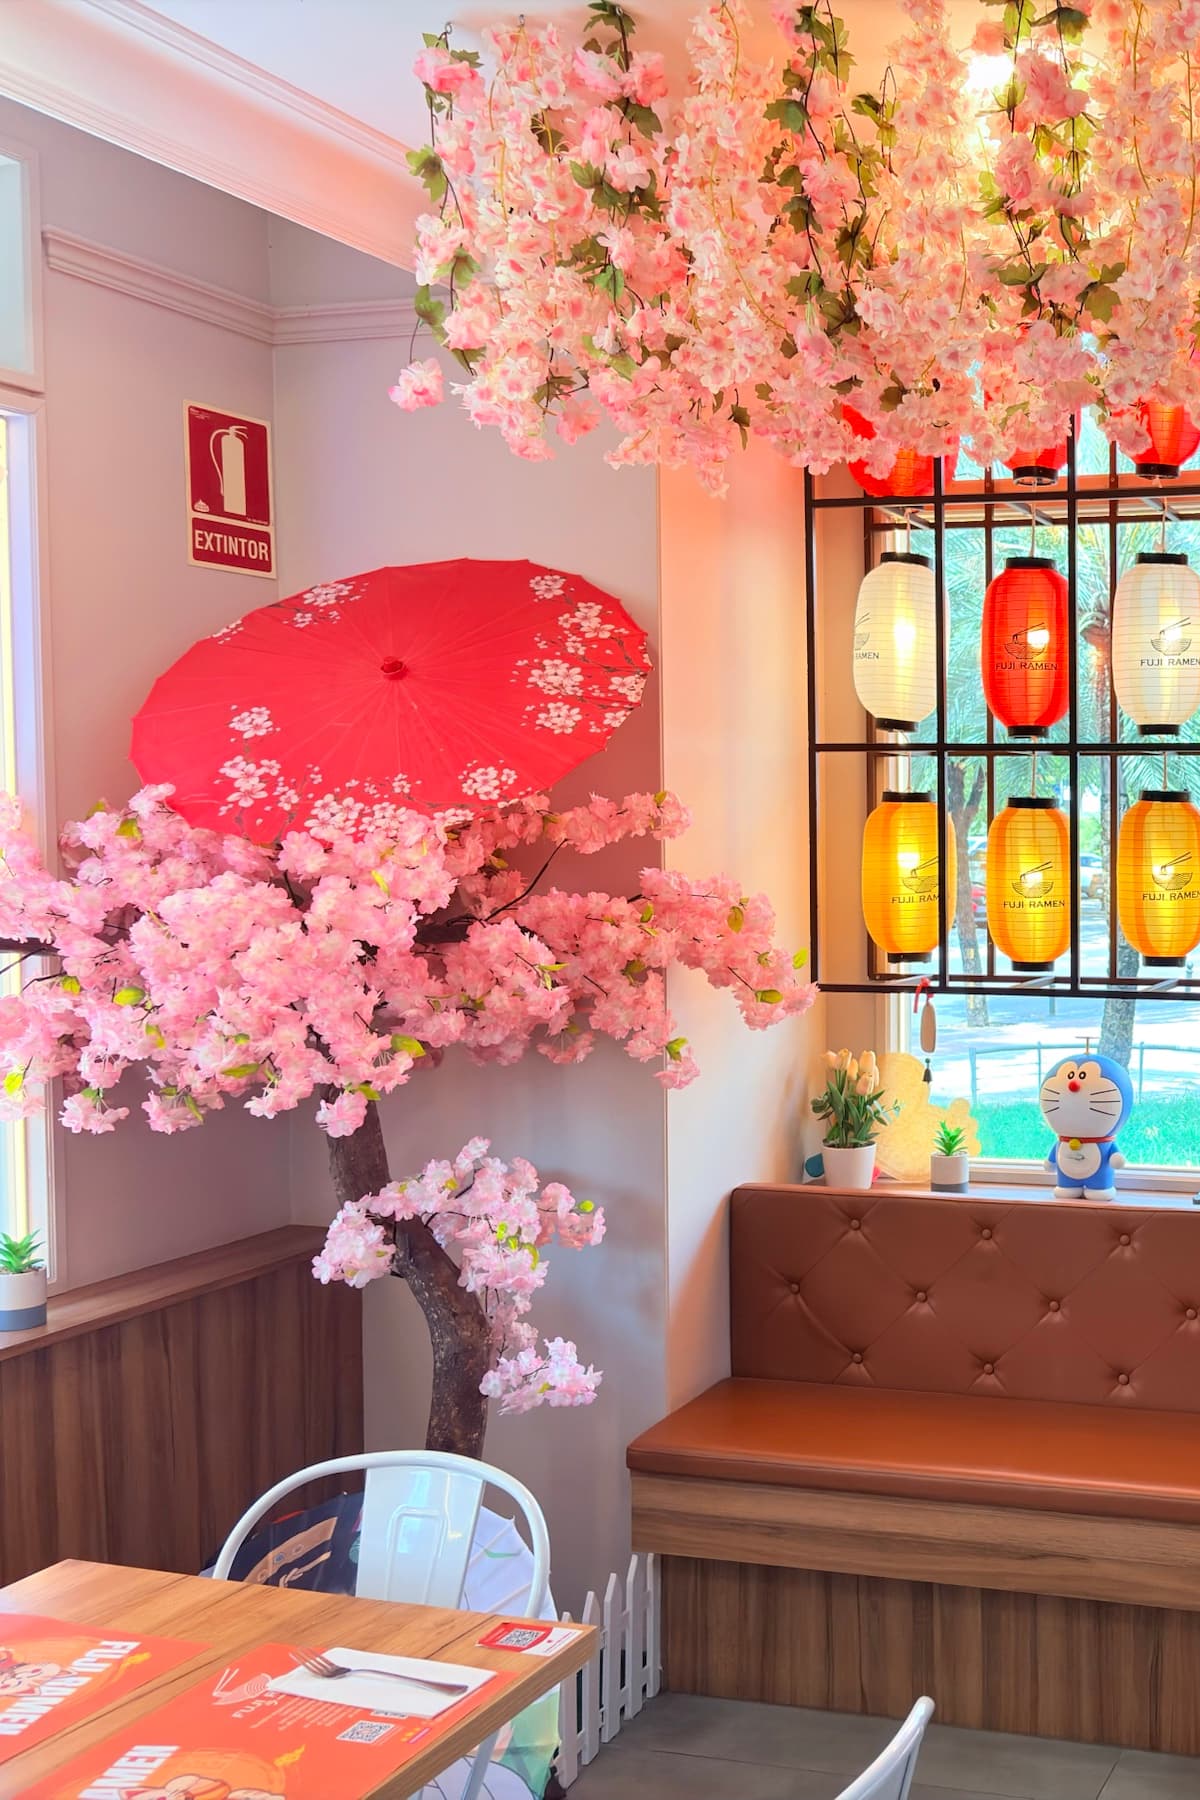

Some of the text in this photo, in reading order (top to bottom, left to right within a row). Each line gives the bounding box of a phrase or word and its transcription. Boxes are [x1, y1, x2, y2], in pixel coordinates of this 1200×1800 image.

[194, 529, 269, 562] EXTINTOR
[995, 661, 1058, 671] FUJI RAMEN
[1140, 657, 1200, 667] FUJI RAMEN
[891, 893, 939, 904] FUJI RAM
[1142, 892, 1165, 902] FUJI
[1003, 899, 1065, 909] FUJI RAMEN
[70, 1640, 142, 1673] FUJI
[77, 1745, 181, 1800] AMEN
